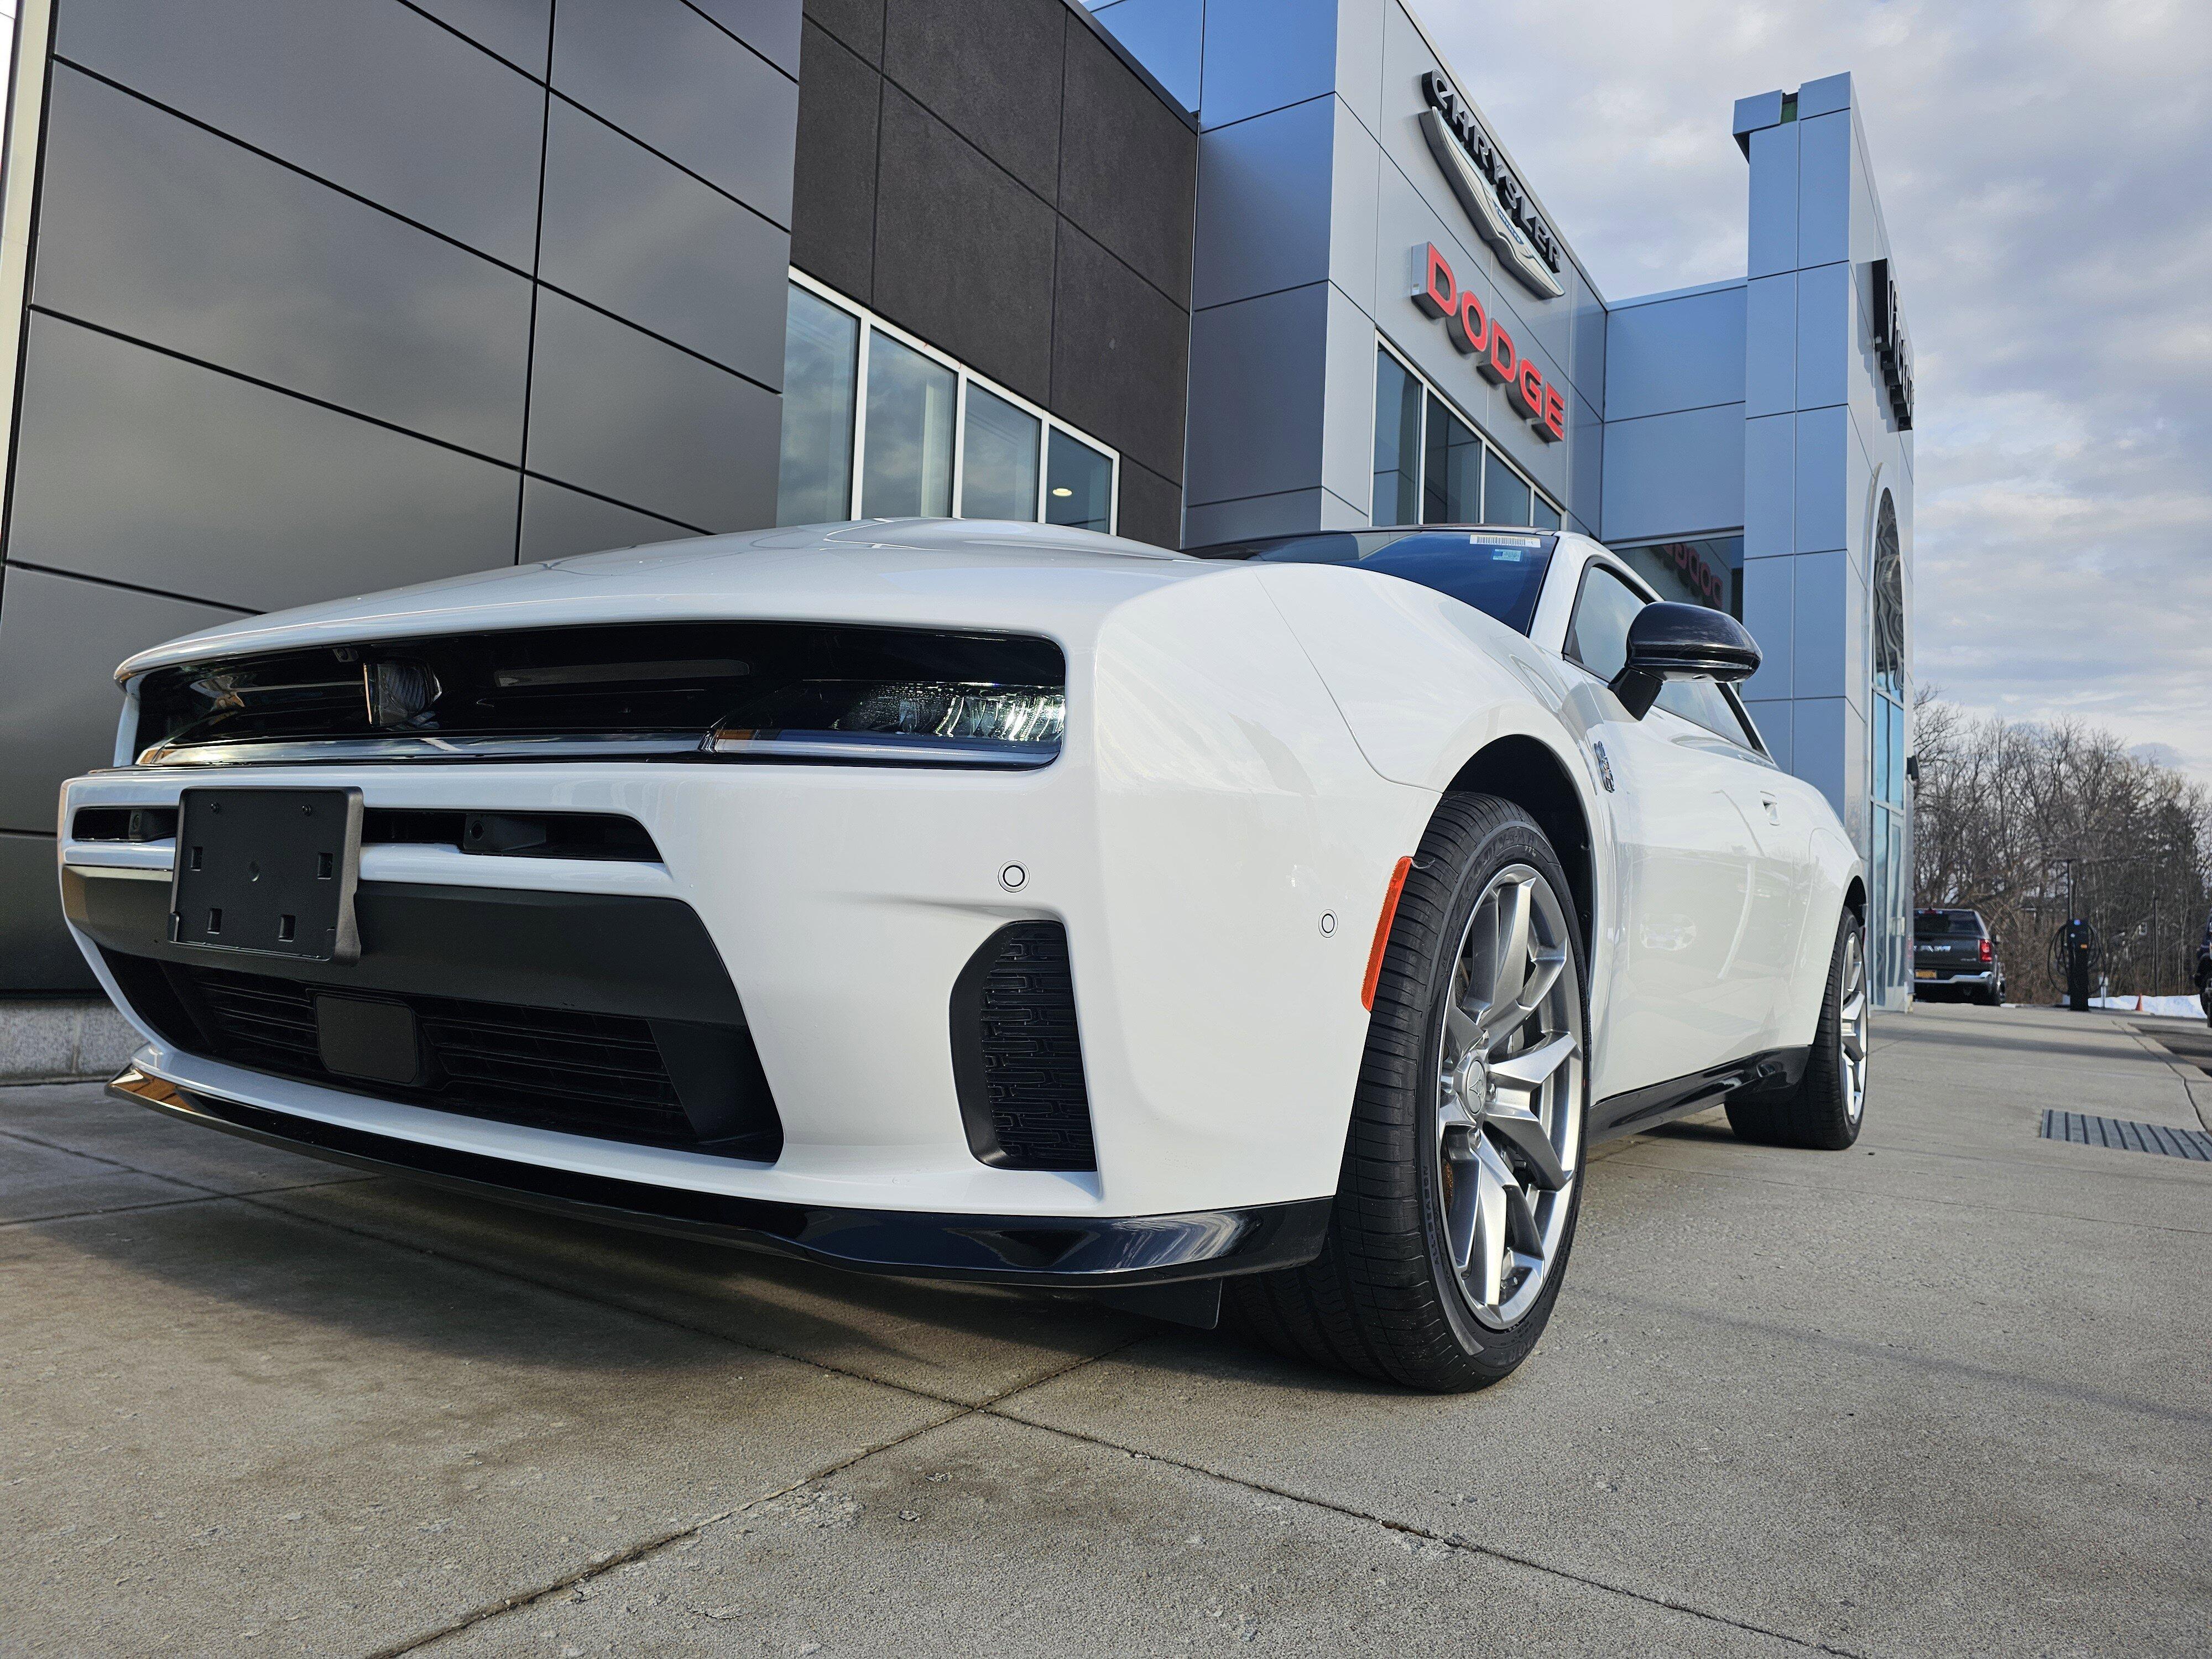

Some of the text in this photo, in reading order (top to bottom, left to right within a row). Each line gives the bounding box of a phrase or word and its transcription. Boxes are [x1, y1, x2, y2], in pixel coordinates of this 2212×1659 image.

[1423, 69, 1561, 273] CHRYSLER
[1425, 242, 1564, 441] DODGE
[1423, 1166, 1439, 1265] ALL-SEASON
